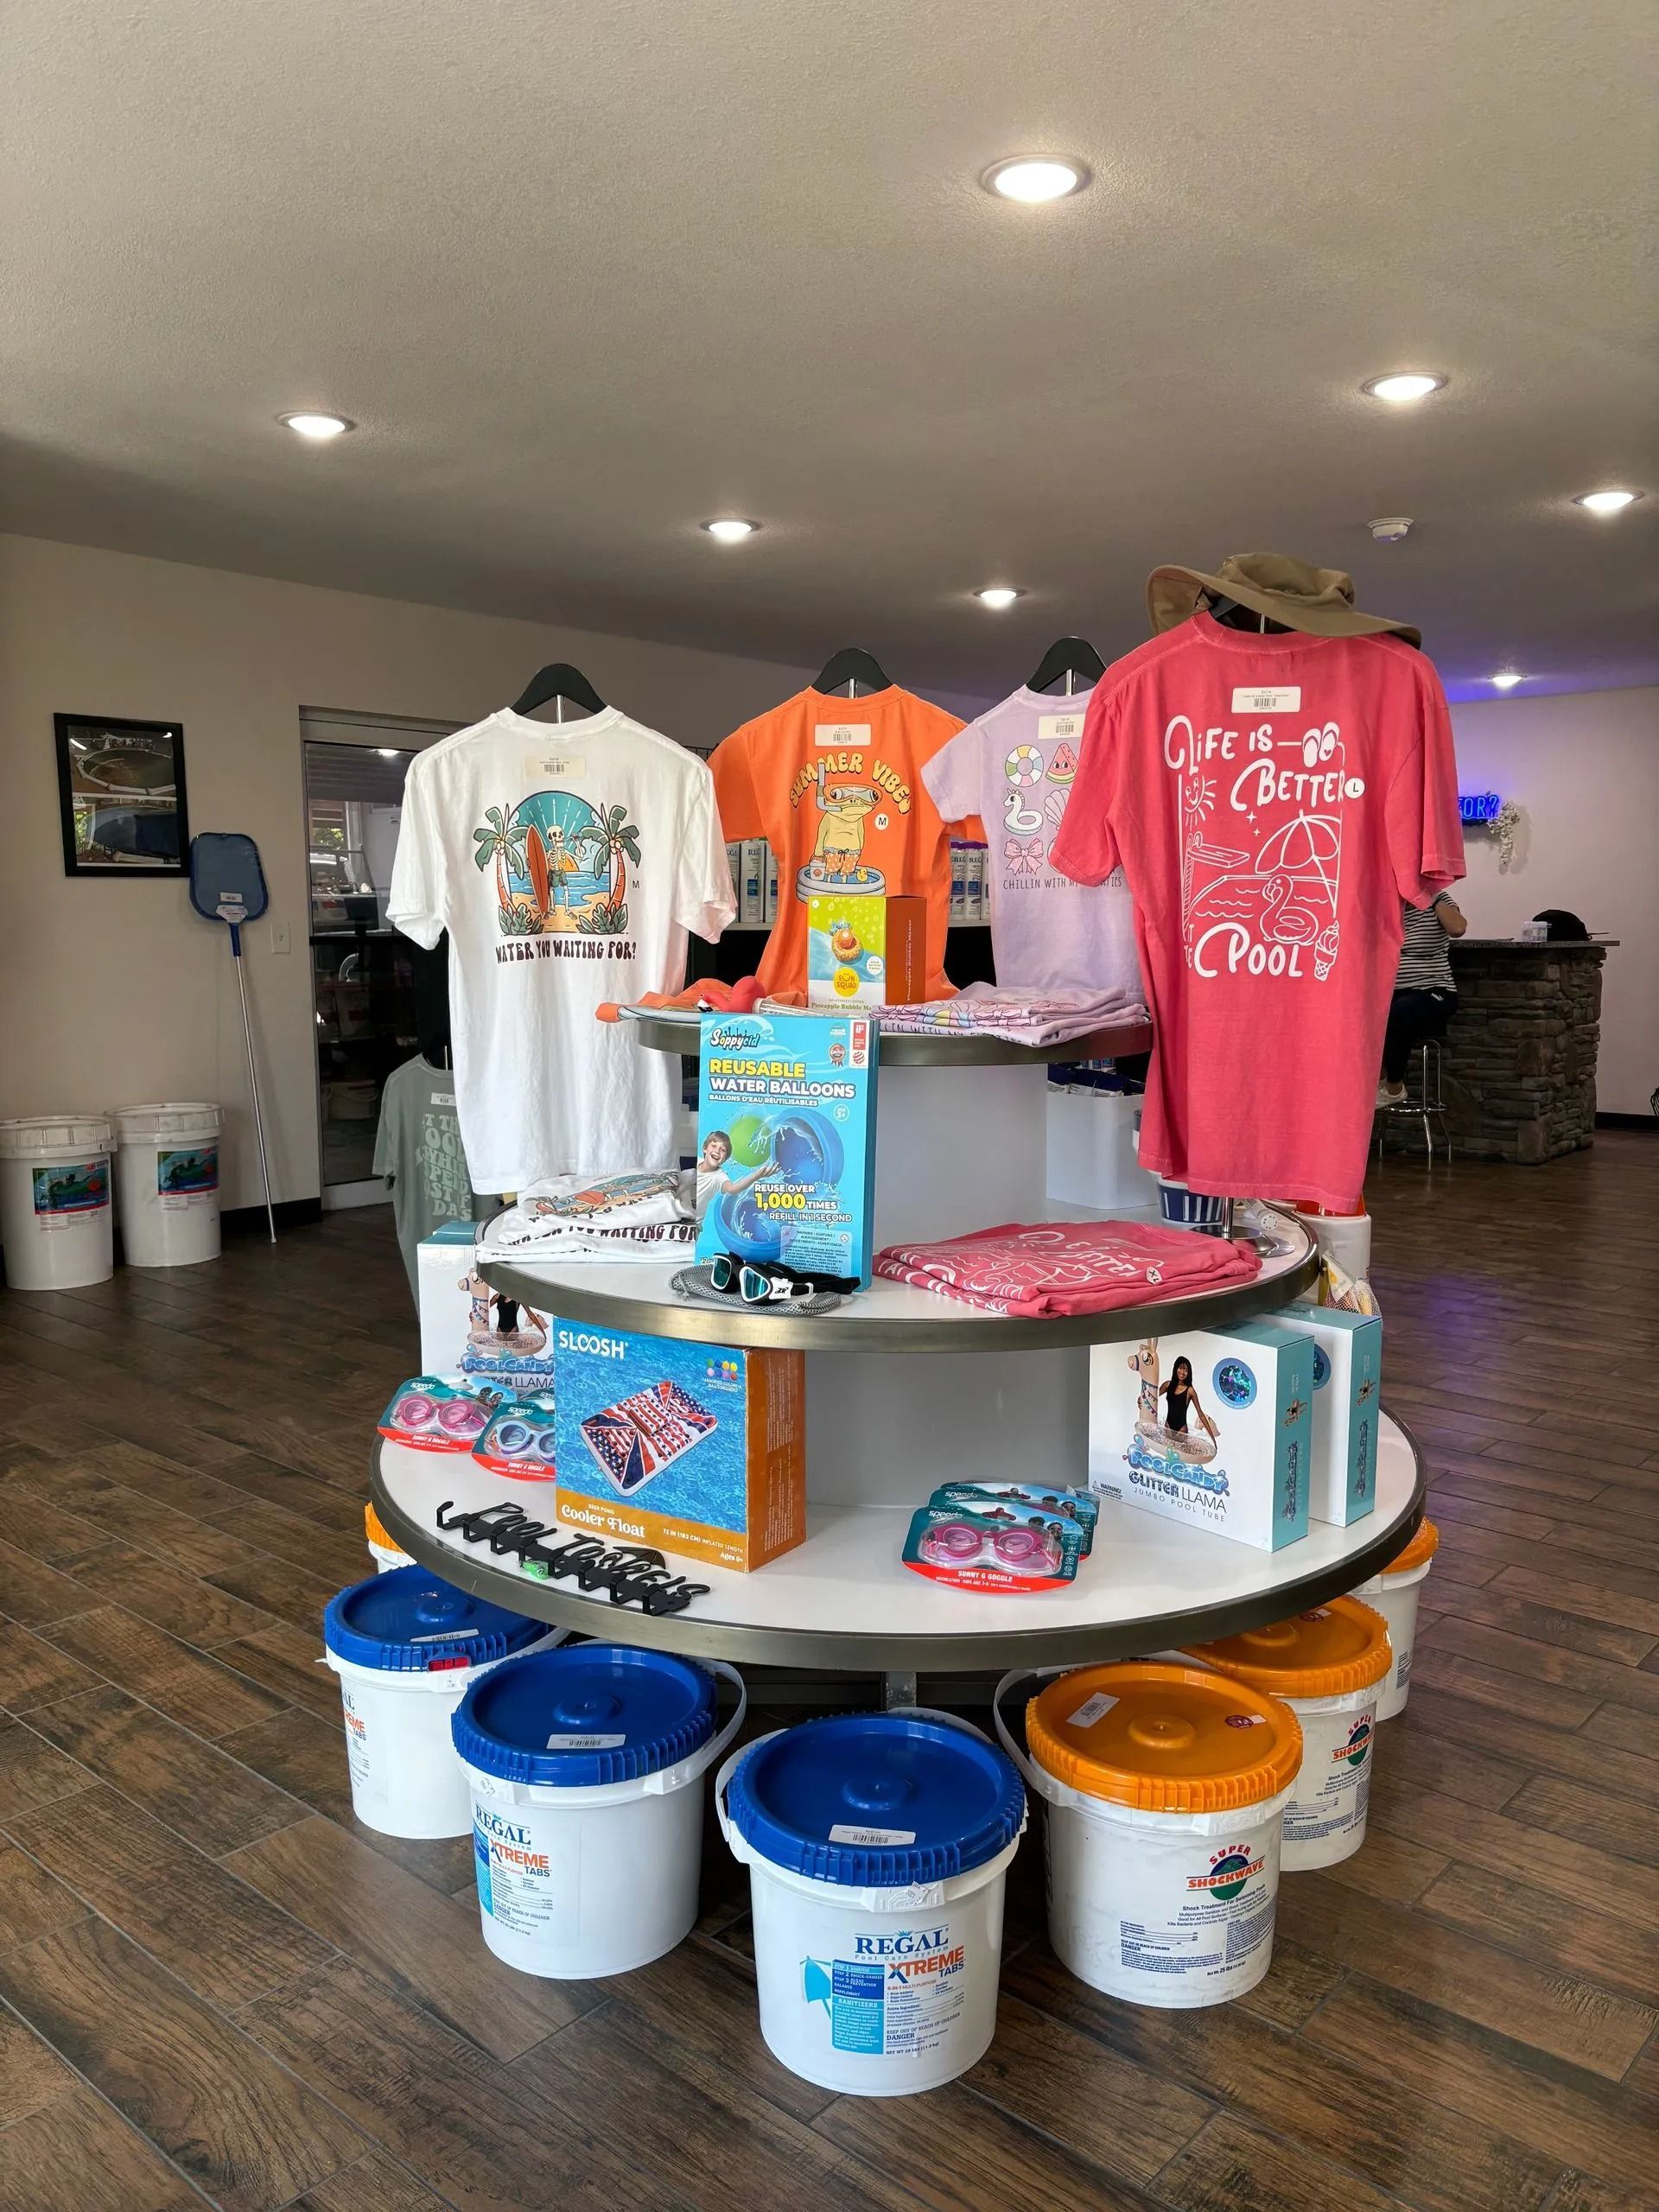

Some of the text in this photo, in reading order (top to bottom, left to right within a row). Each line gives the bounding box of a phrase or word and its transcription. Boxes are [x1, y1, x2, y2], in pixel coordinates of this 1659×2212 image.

[1249, 724, 1273, 752] IS
[789, 752, 912, 815] SUMMER VIBES
[1352, 782, 1359, 793] L
[878, 817, 887, 826] M
[632, 880, 639, 889] M
[1003, 878, 1065, 889] CHILLIN WITH
[495, 942, 534, 963] WATER
[553, 939, 604, 959] WAITING
[607, 941, 637, 960] FOR?
[709, 1058, 805, 1078] REUSABLE
[710, 1077, 856, 1098] WATER BALLOONS
[754, 1184, 785, 1192] REUSE
[754, 1192, 837, 1211] 1,000 TIMES
[769, 1212, 798, 1221] REFILL
[559, 1331, 625, 1359] SLOOSH
[1129, 1471, 1179, 1497] GLITTER
[1182, 1487, 1227, 1513] LLAMA
[1134, 1487, 1165, 1502] JUMBO
[1171, 1499, 1197, 1512] POOL
[1203, 1510, 1224, 1522] TUBE
[562, 1504, 645, 1538] Cooler Float
[929, 1510, 963, 1519] speedo
[702, 1539, 724, 1548] INFLATED
[724, 1543, 743, 1553] LENGTH
[720, 1551, 734, 1561] Ages
[988, 1573, 1013, 1582] GOGGLE
[475, 1803, 531, 1845] REGAL
[1210, 1845, 1251, 1865] SUPER
[524, 1866, 550, 1877] TABS
[1188, 1859, 1264, 1888] SHOCKWAVE
[1201, 1901, 1226, 1910] Treatment
[855, 1929, 949, 1955] REGAL
[888, 1945, 964, 1984] XTREME
[938, 1961, 964, 1978] TABS
[838, 1998, 878, 2008] SANITIZERS
